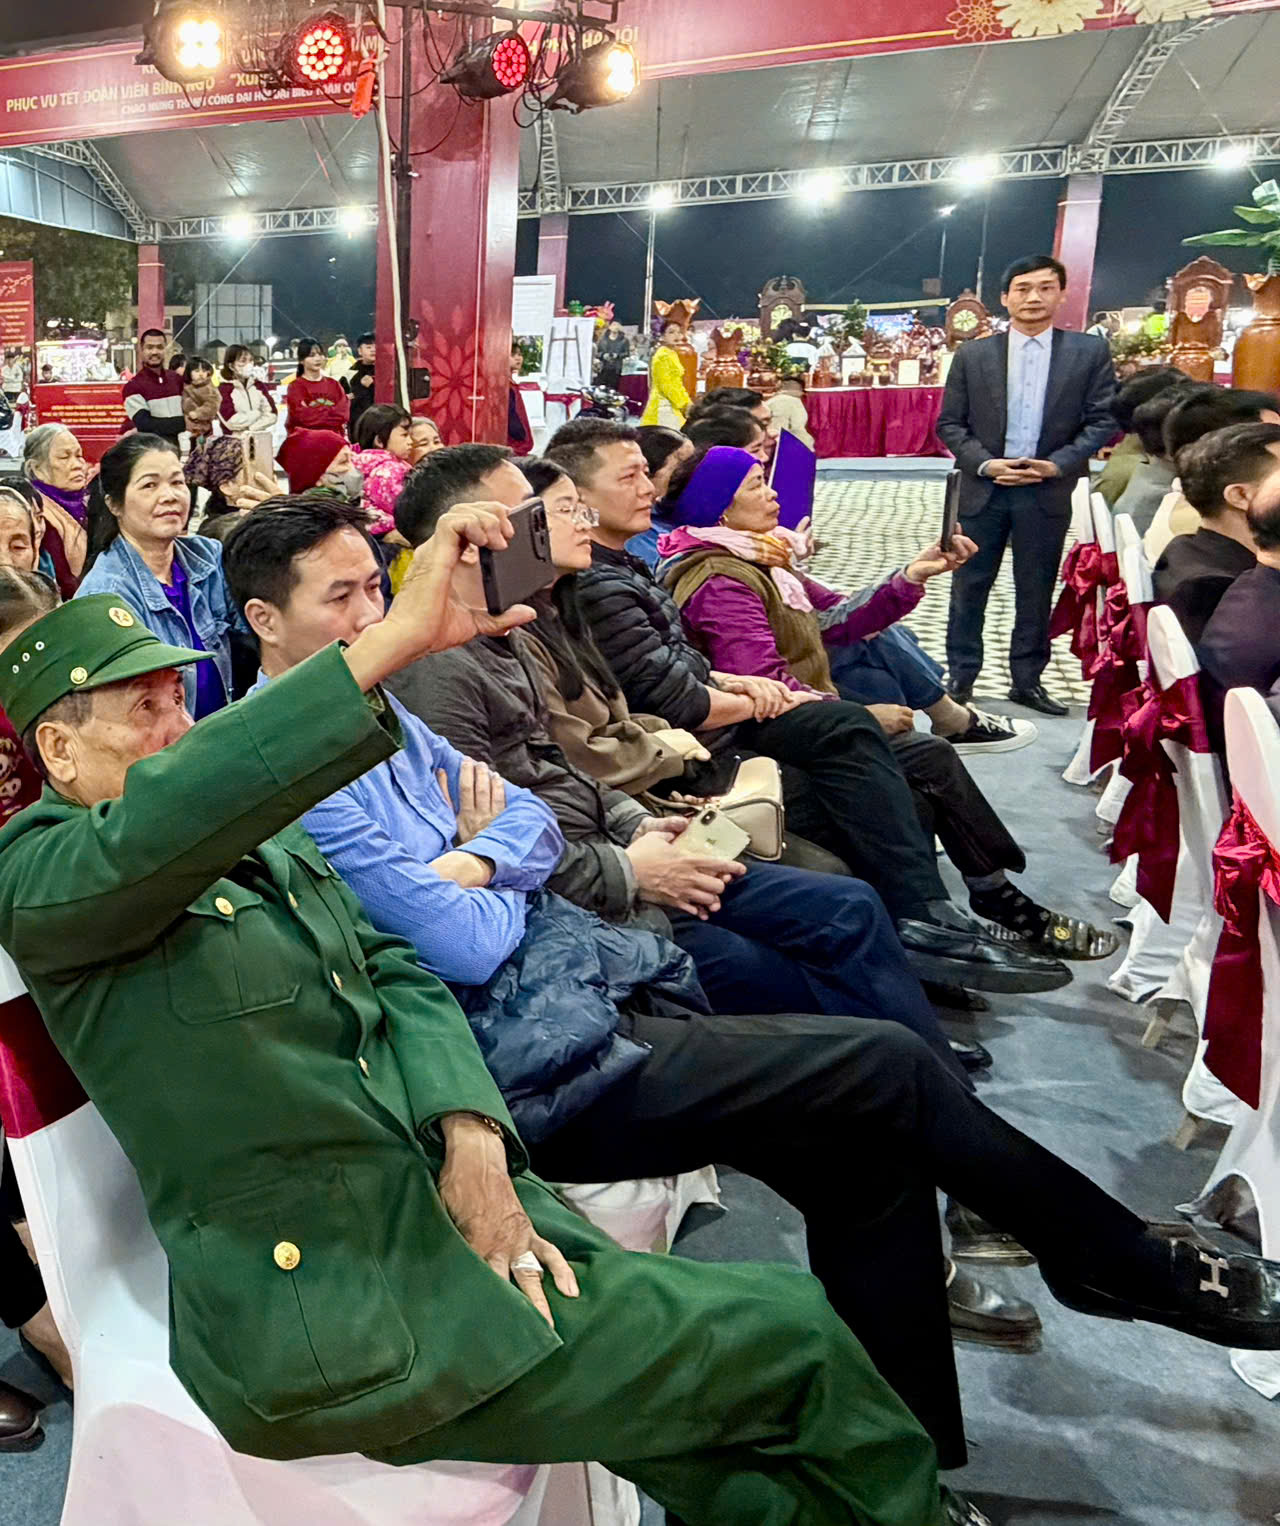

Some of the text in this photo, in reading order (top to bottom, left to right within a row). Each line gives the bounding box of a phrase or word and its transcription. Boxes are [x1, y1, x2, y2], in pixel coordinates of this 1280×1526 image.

[6, 96, 37, 112] PHỤC
[40, 94, 57, 109] VỤ
[60, 88, 79, 105] TẾT
[121, 81, 149, 98] VIÊN
[208, 91, 234, 106] CÔNG
